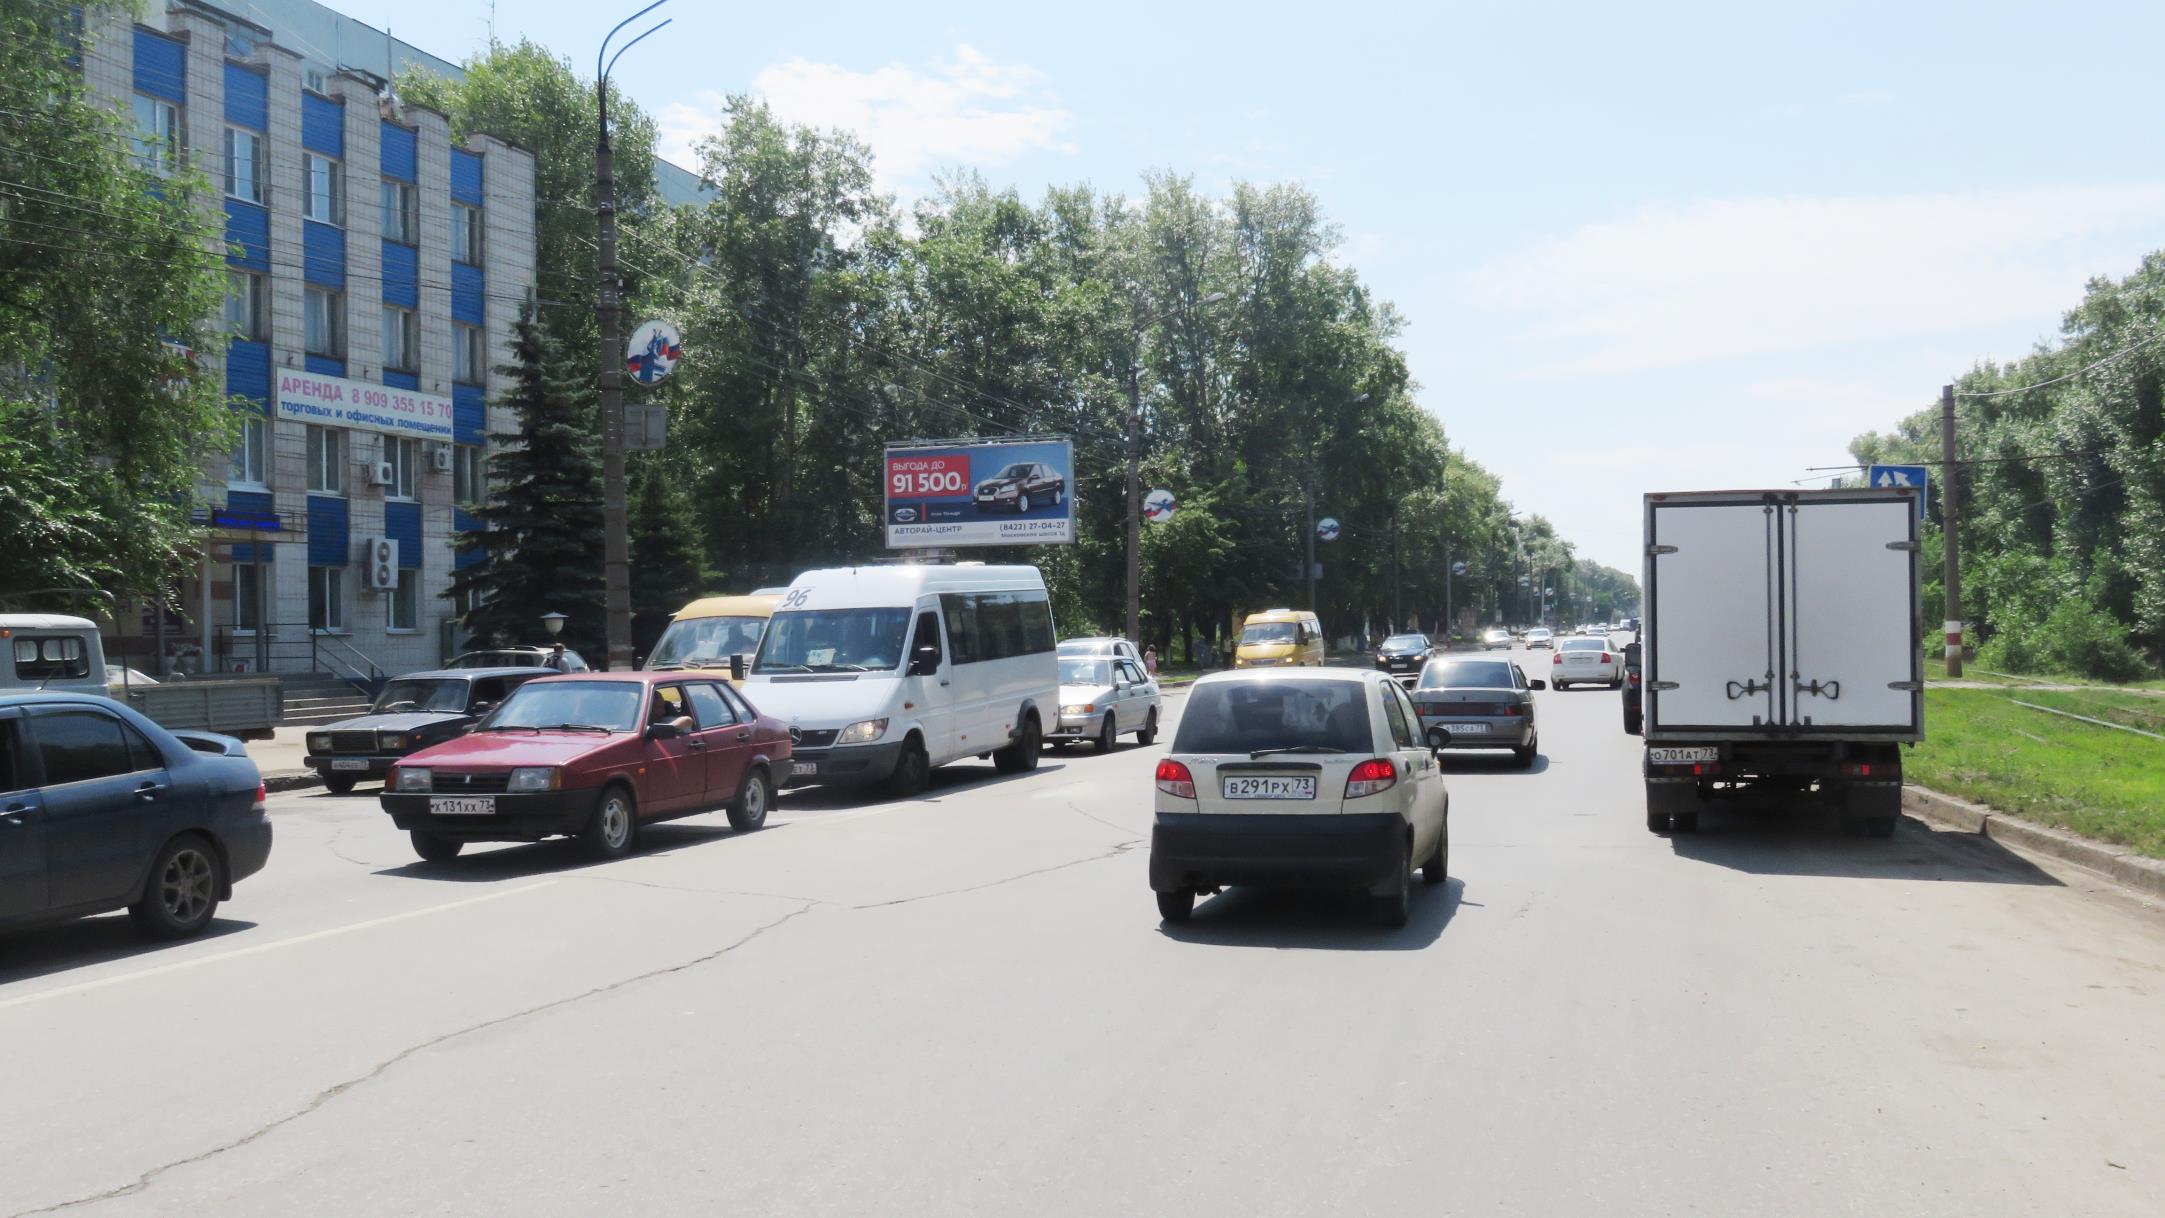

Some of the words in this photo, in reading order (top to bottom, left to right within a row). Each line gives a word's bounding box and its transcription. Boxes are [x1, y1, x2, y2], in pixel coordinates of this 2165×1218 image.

[281, 376, 343, 401] АРЕНДА
[352, 388, 360, 404] 8
[364, 389, 388, 409] 909
[393, 395, 415, 413] 355
[419, 400, 434, 417] 15
[438, 403, 452, 419] 70
[281, 400, 332, 418] торговых
[336, 409, 343, 418] и
[346, 409, 394, 427] офисных
[397, 418, 452, 435] помещений
[892, 462, 928, 471] ВЫГОДА
[931, 461, 945, 470] ДО
[892, 473, 913, 493] 91
[894, 525, 962, 535] АВТОРАЙ-ЦЕНТР
[999, 523, 1026, 532] (8422)
[1029, 521, 1065, 530] 27-04-27
[782, 589, 812, 608] 96
